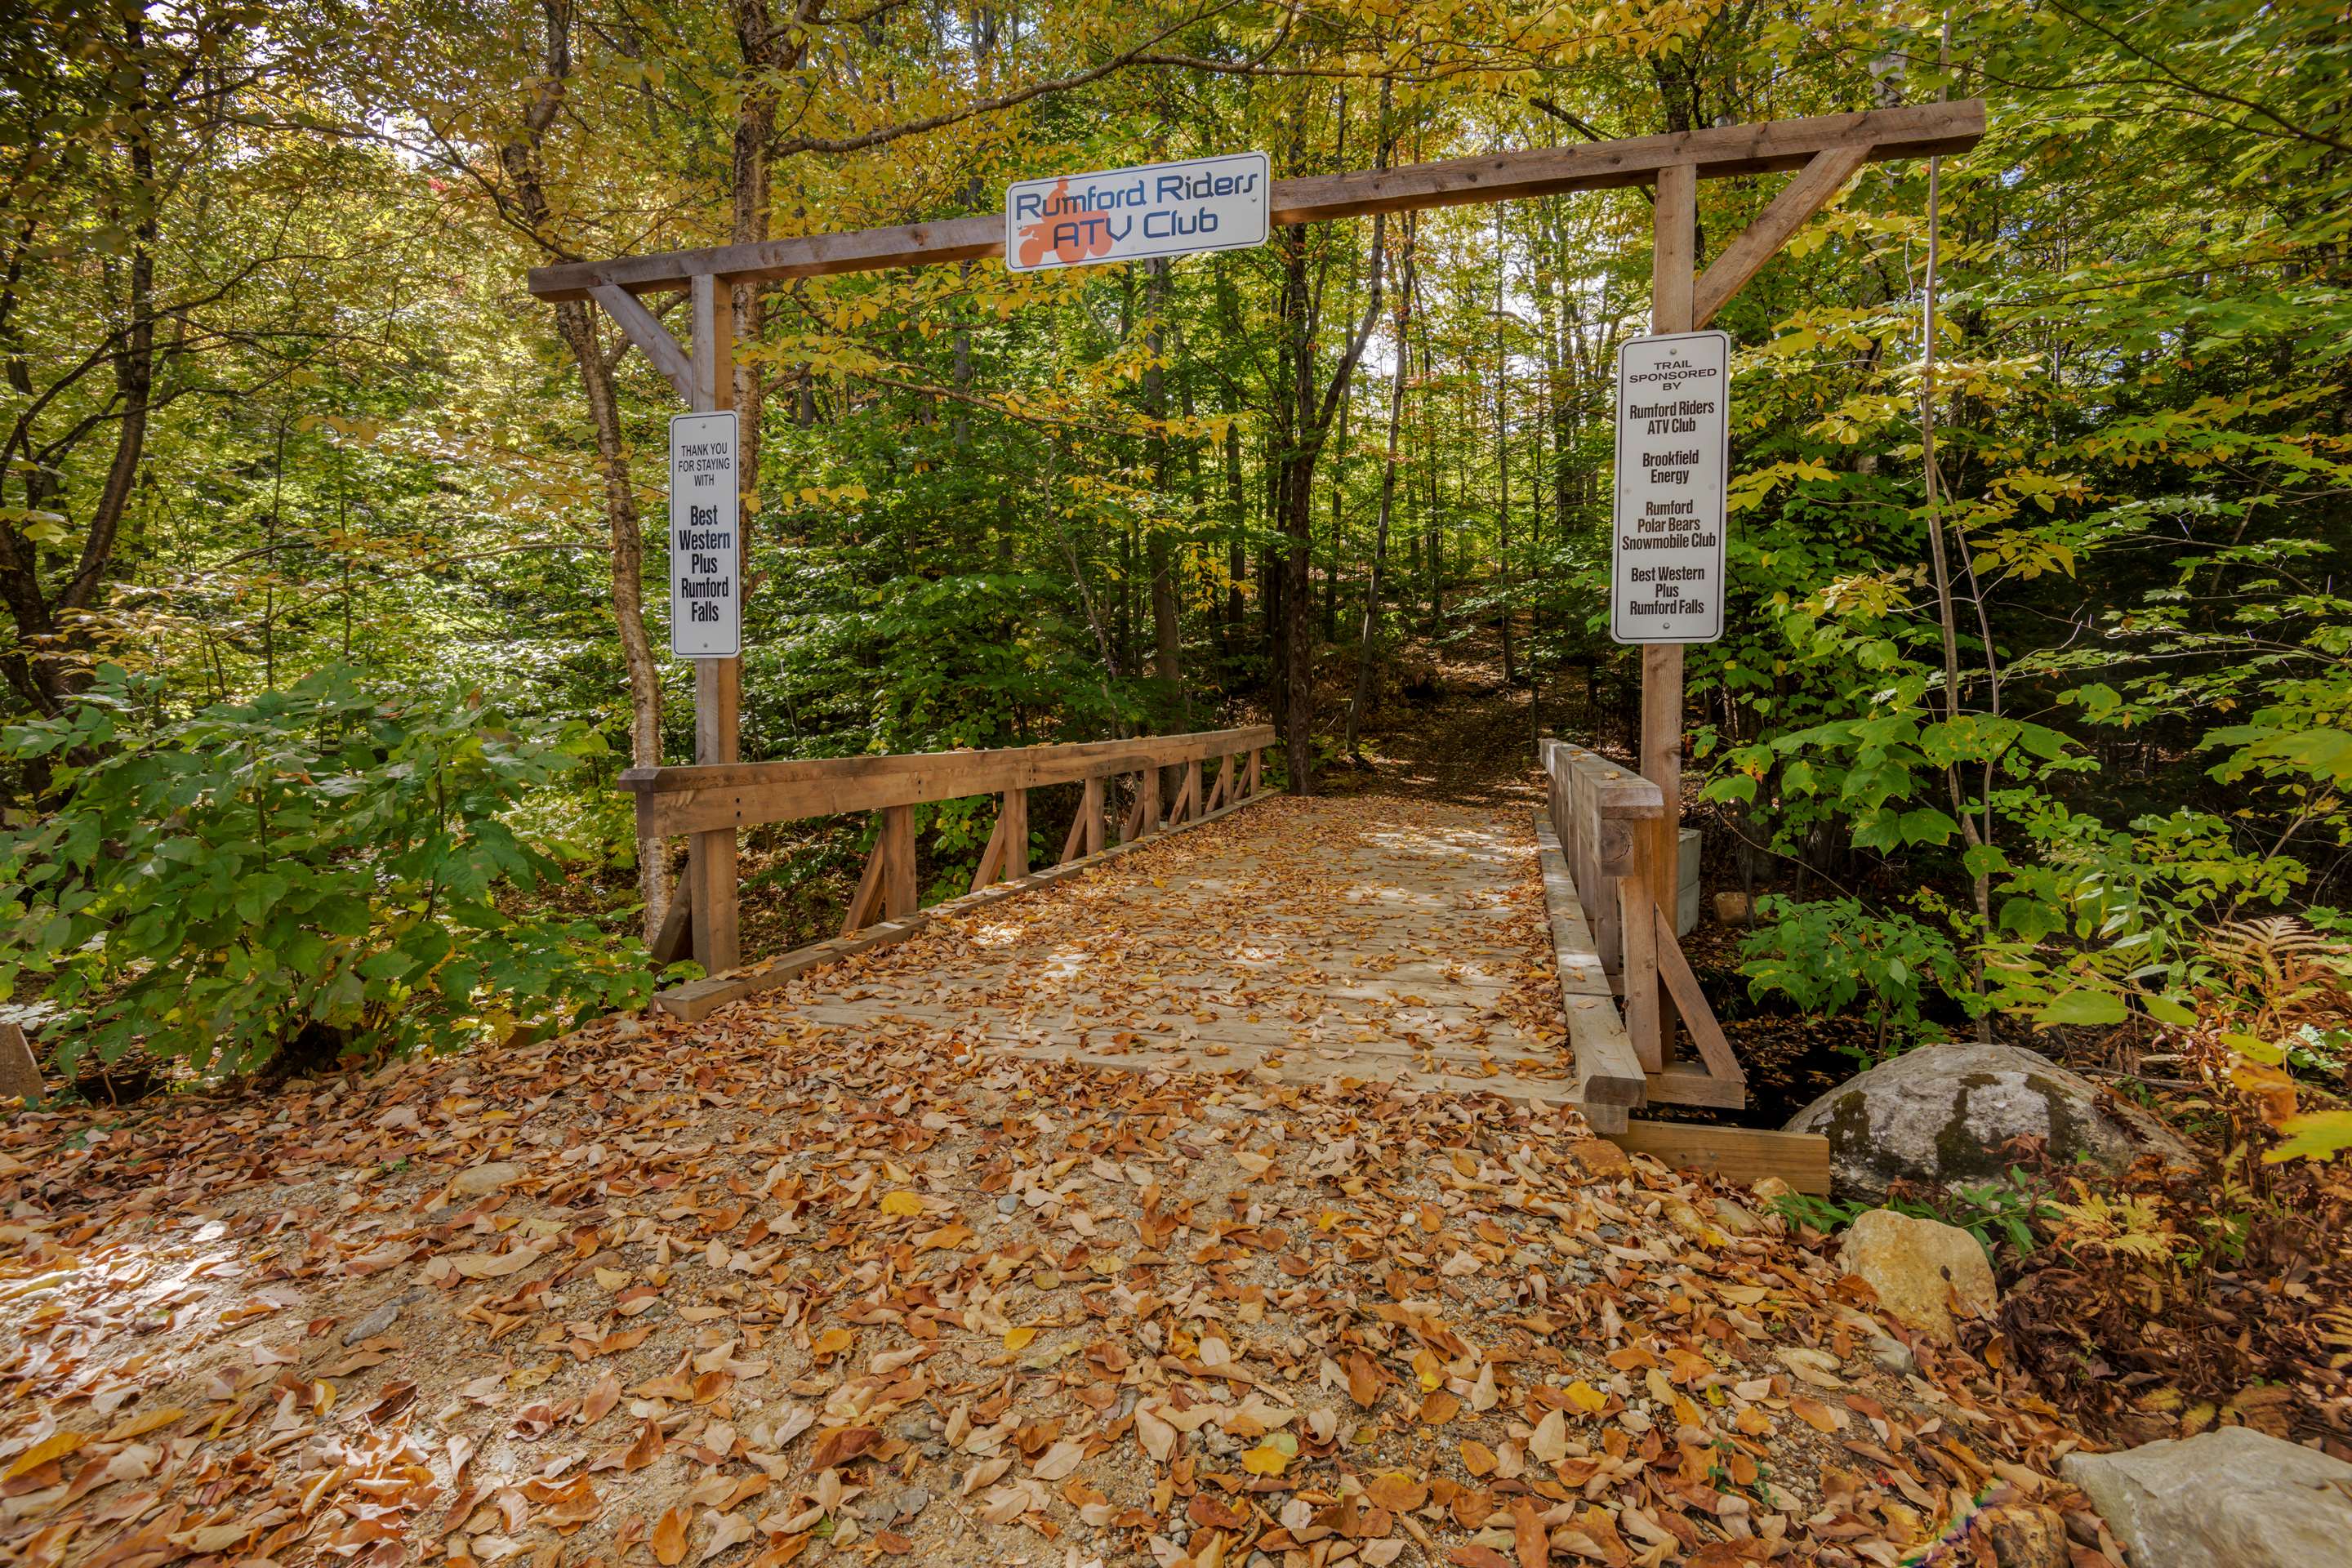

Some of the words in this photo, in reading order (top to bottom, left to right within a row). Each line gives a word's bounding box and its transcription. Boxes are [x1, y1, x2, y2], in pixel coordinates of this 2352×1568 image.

[1017, 180, 1147, 220] Rumford
[1157, 172, 1258, 203] Riders
[1054, 215, 1132, 249] ATV
[1143, 207, 1218, 238] Club
[1654, 360, 1692, 369] TRAIL
[1629, 368, 1717, 383] SPONSORED
[1663, 382, 1682, 390] BY
[1630, 402, 1677, 419] Rumford
[1679, 401, 1714, 416] Riders
[1647, 419, 1669, 434] ATV
[1672, 417, 1695, 433] Club
[681, 444, 709, 457] THANK
[710, 443, 728, 454] YOU
[678, 461, 694, 472] FOR
[697, 457, 730, 470] STAYING
[1642, 450, 1699, 467] Brookfield
[694, 474, 715, 486] WITH
[1650, 469, 1690, 484] Energy
[1646, 499, 1693, 515] Rumford
[691, 505, 718, 526] Best
[1637, 519, 1667, 532] Polar
[1668, 516, 1700, 531] Bears
[679, 529, 730, 550] Western
[1622, 535, 1690, 550] Snowmobile
[1691, 532, 1716, 547] Club
[692, 554, 717, 574] Plus
[1631, 568, 1656, 581] Best
[1658, 566, 1704, 581] Western
[681, 577, 728, 598] Rumford
[1655, 583, 1679, 598] Plus
[692, 601, 719, 621] Falls
[1630, 600, 1677, 615] Rumford
[1679, 599, 1704, 613] Falls
